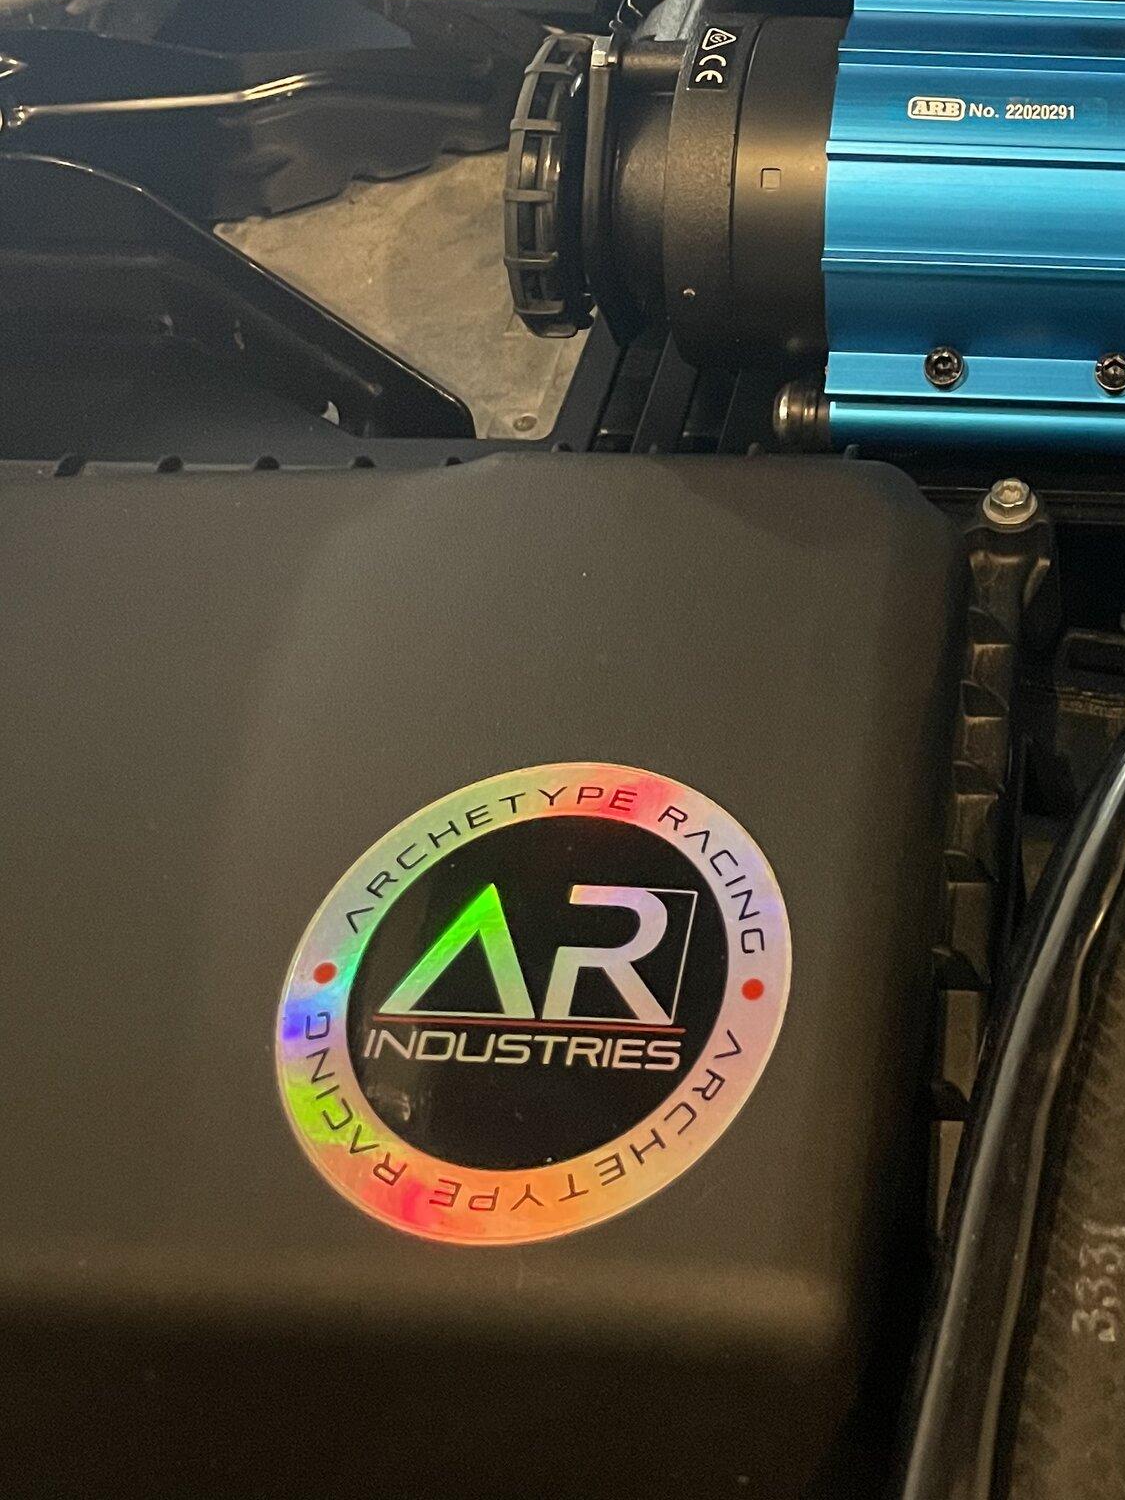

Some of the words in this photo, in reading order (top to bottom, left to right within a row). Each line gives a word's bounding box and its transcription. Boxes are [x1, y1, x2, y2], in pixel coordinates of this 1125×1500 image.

[911, 99, 963, 117] ARB
[969, 103, 1000, 118] No.
[1004, 103, 1075, 120] 22020291
[344, 785, 639, 934] ARCHETYPE
[656, 804, 767, 956] RACING
[379, 883, 690, 1025] AR
[304, 1011, 407, 1186] RACING
[363, 1029, 682, 1071] INDUSTRIES
[429, 1029, 743, 1212] ARCHETYPE
